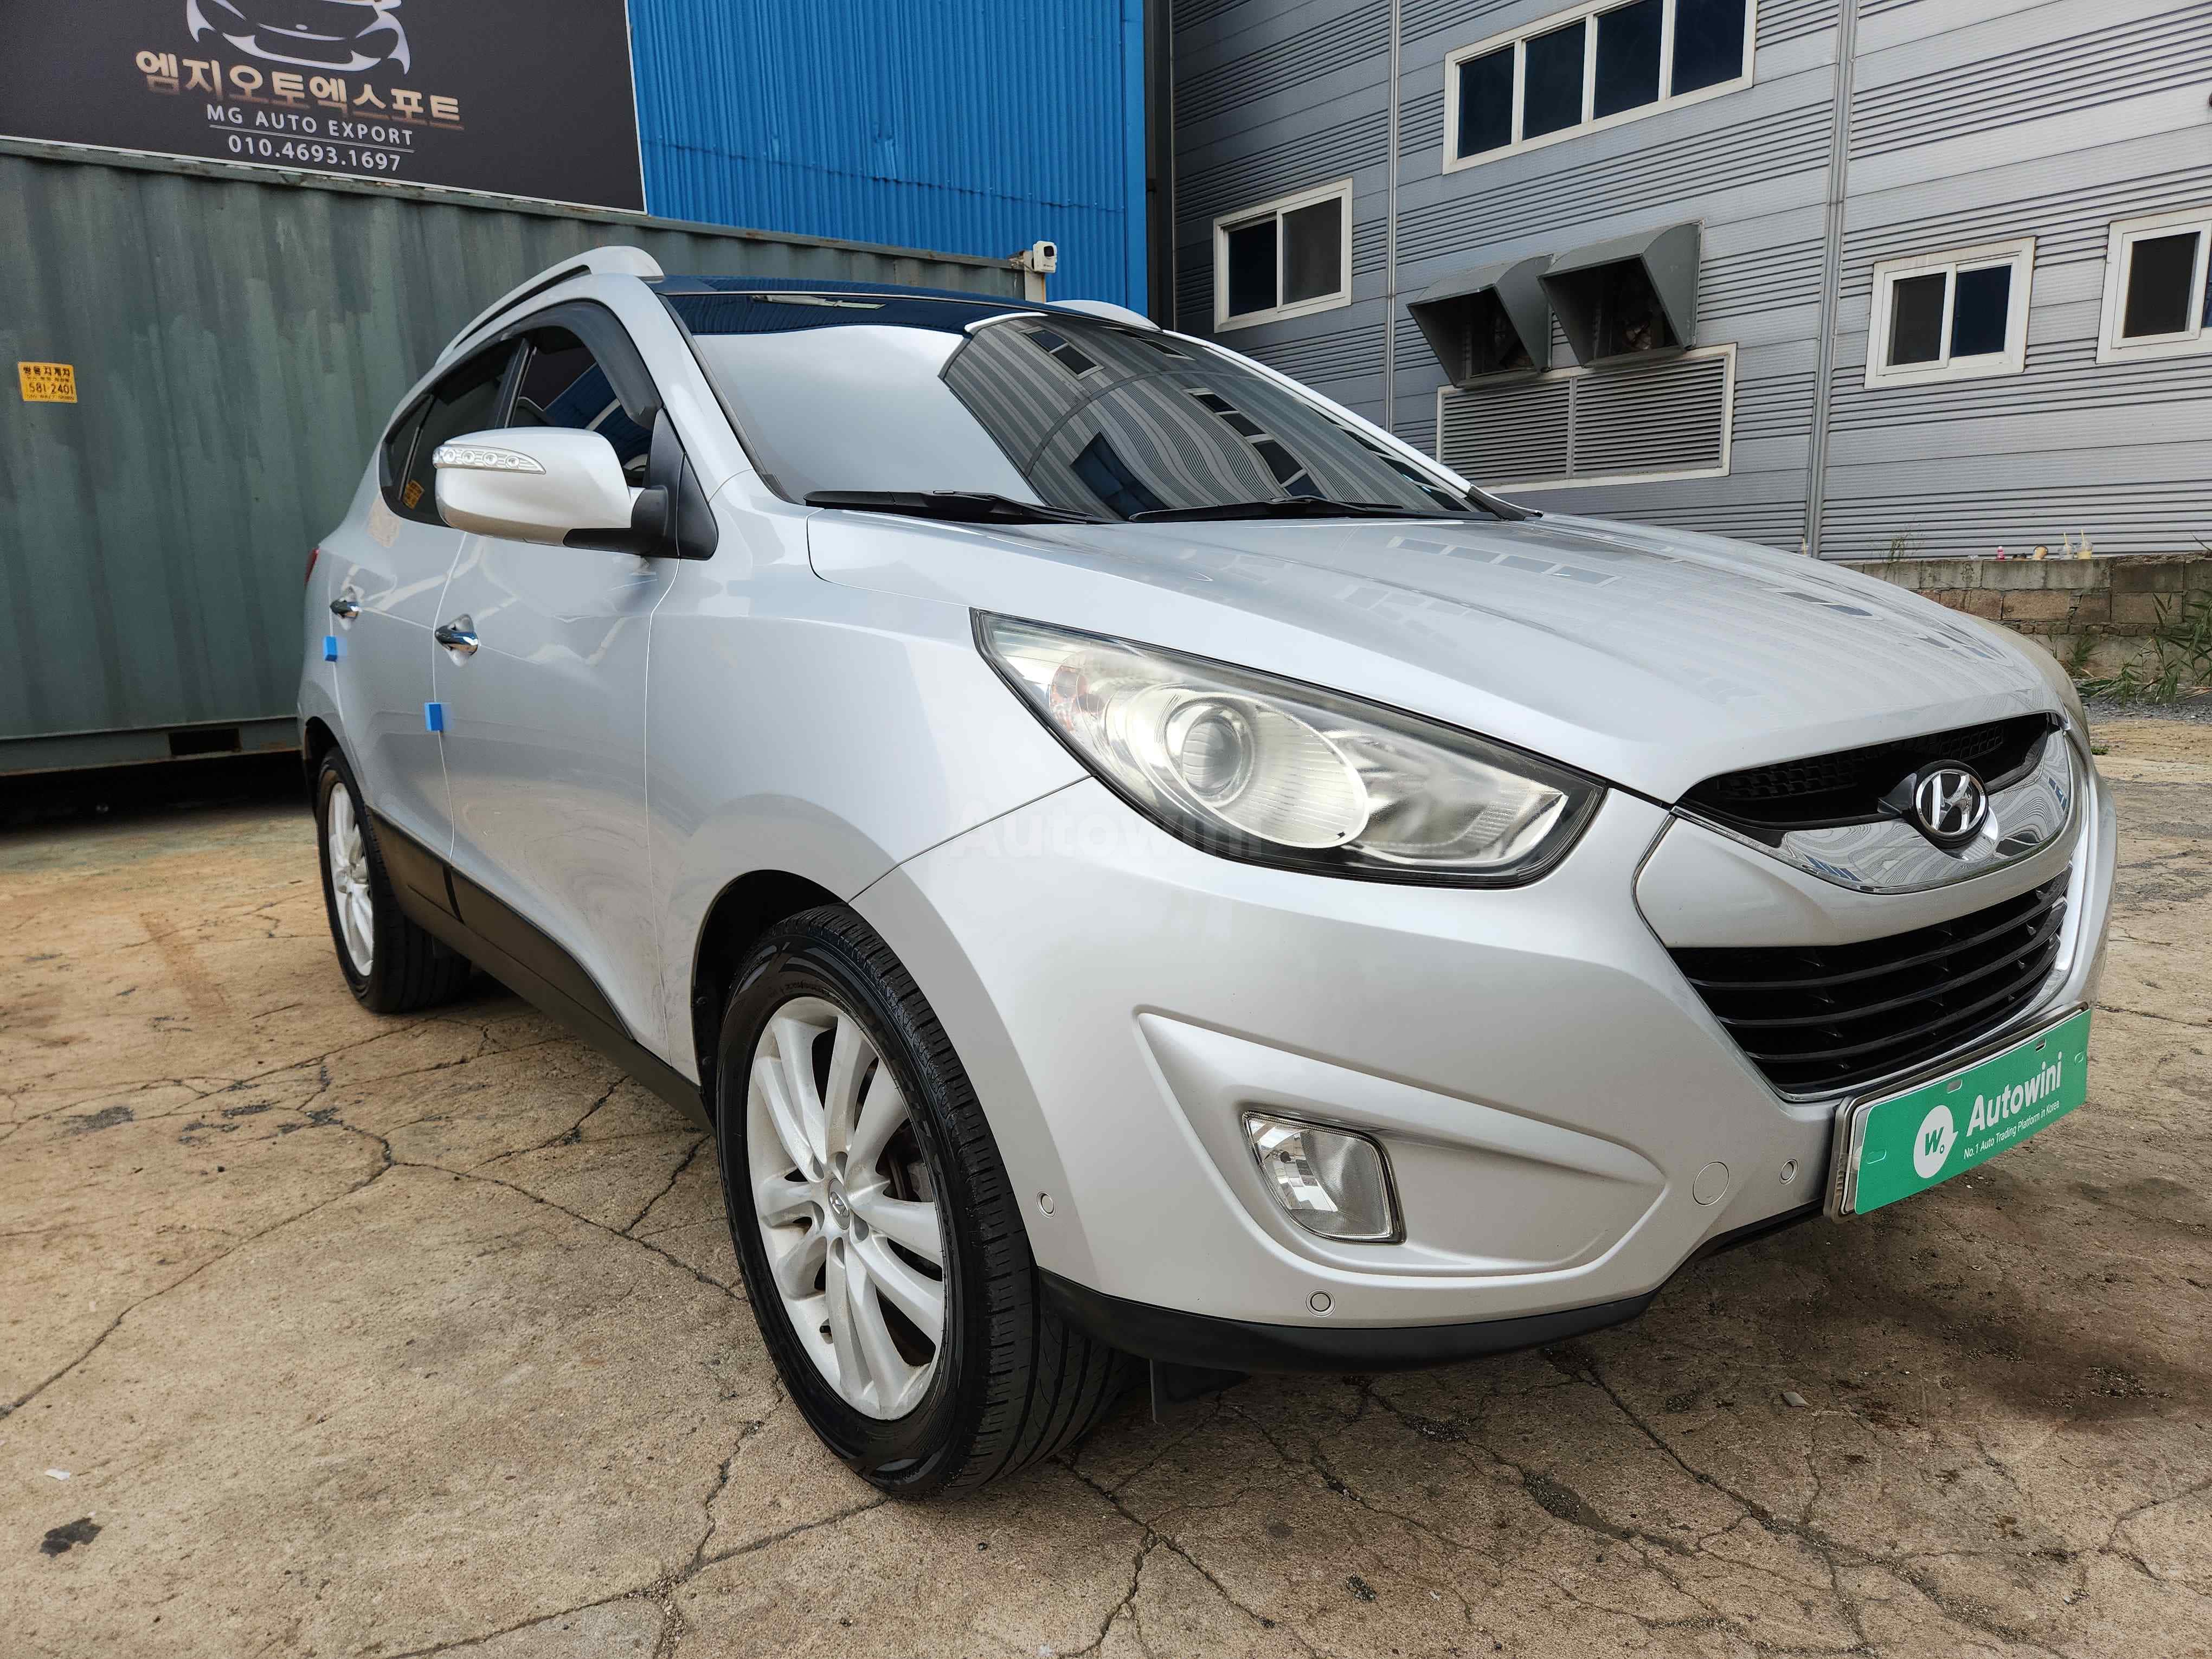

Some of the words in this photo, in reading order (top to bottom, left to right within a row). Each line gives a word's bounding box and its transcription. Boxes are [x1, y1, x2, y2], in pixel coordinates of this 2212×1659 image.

[136, 50, 465, 130] 엠지오토엑스포트
[207, 104, 243, 125] MG
[255, 111, 317, 134] AUTO
[328, 119, 413, 146] EXPORT
[228, 134, 400, 171] 010.4693.1697
[1966, 1051, 2062, 1136] Autowini
[1979, 1137, 1995, 1152] Auto
[1996, 1126, 2017, 1143] Trading
[2017, 1113, 2040, 1132] Platform
[2040, 1108, 2046, 1118] in
[2046, 1100, 2060, 1115] Korea
